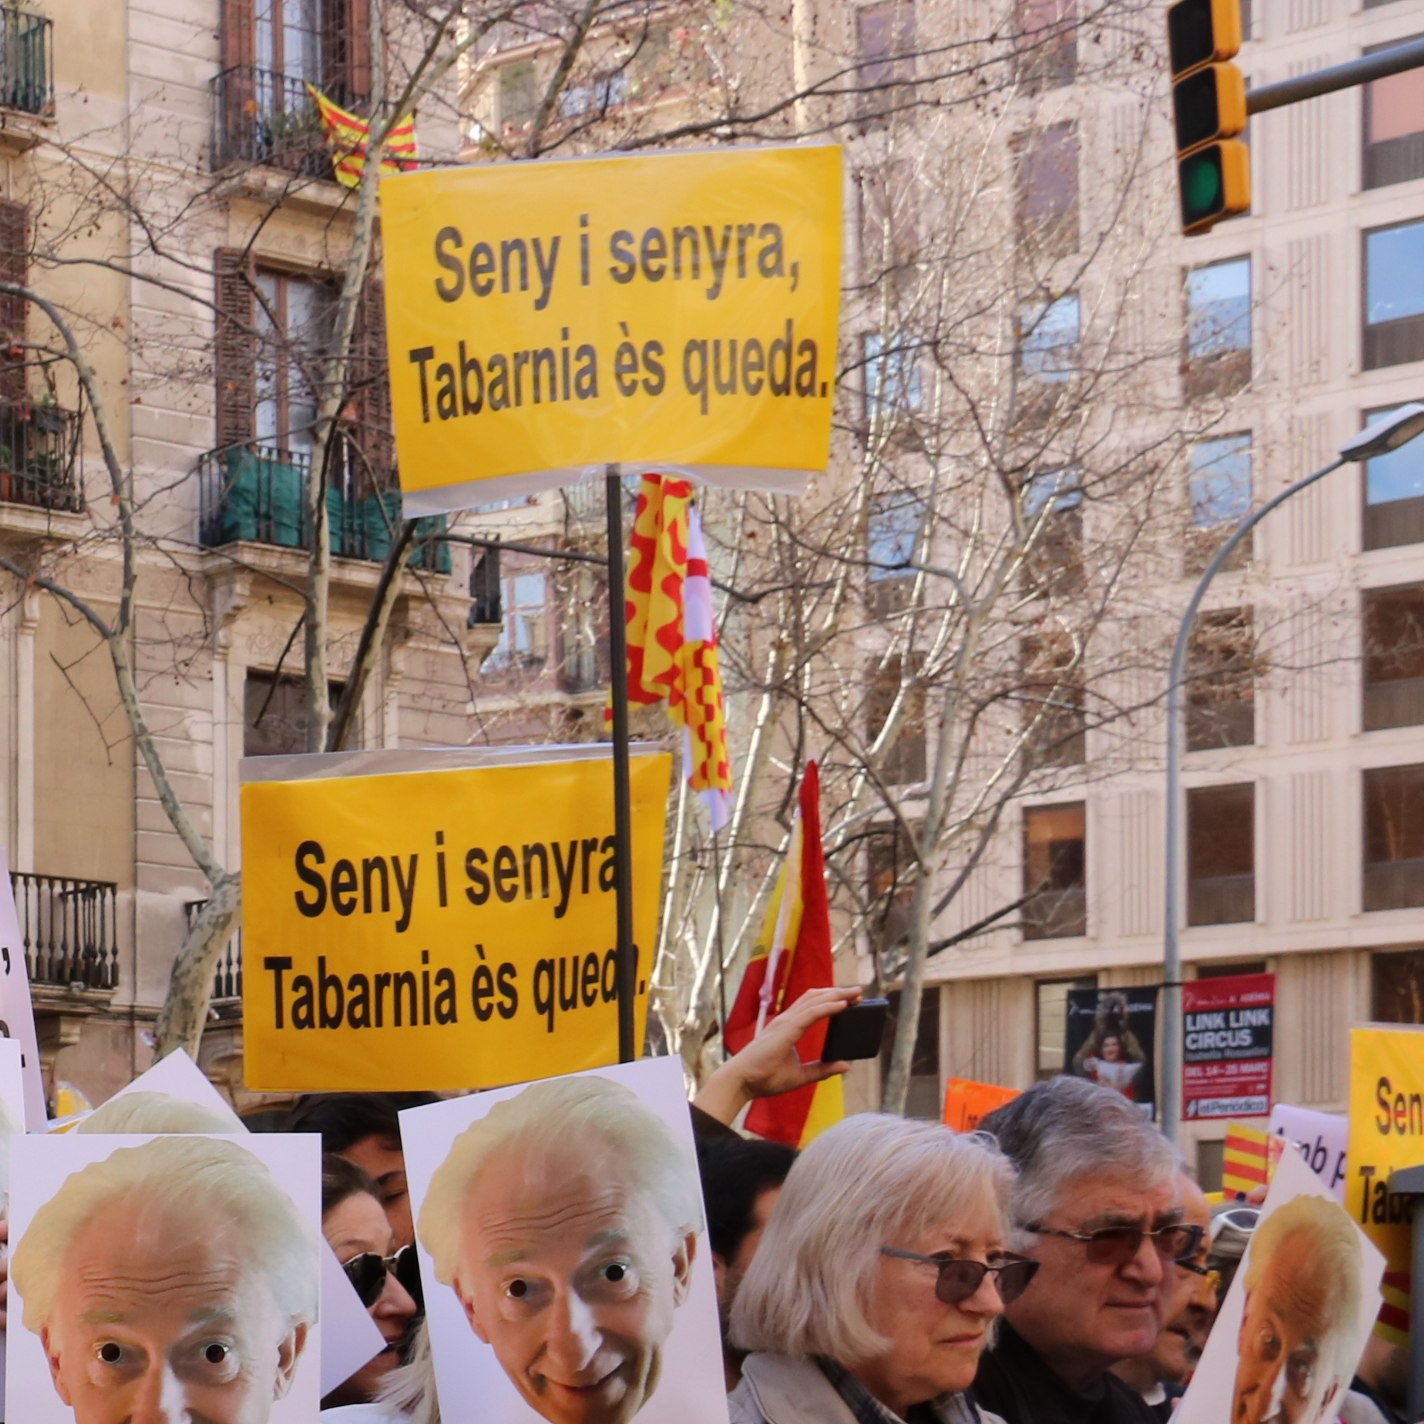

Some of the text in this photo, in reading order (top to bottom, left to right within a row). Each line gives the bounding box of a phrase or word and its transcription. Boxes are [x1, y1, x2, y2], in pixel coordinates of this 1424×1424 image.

[434, 214, 800, 310] Seny i senyra,
[410, 318, 828, 423] Tabarnia ès queda.
[294, 840, 418, 933] Seny
[435, 830, 449, 907] i
[264, 950, 456, 1031] Tabarnia
[471, 944, 518, 1023] ès
[1185, 1008, 1270, 1031] LINK LINK
[1185, 1029, 1252, 1050] CIRCUS
